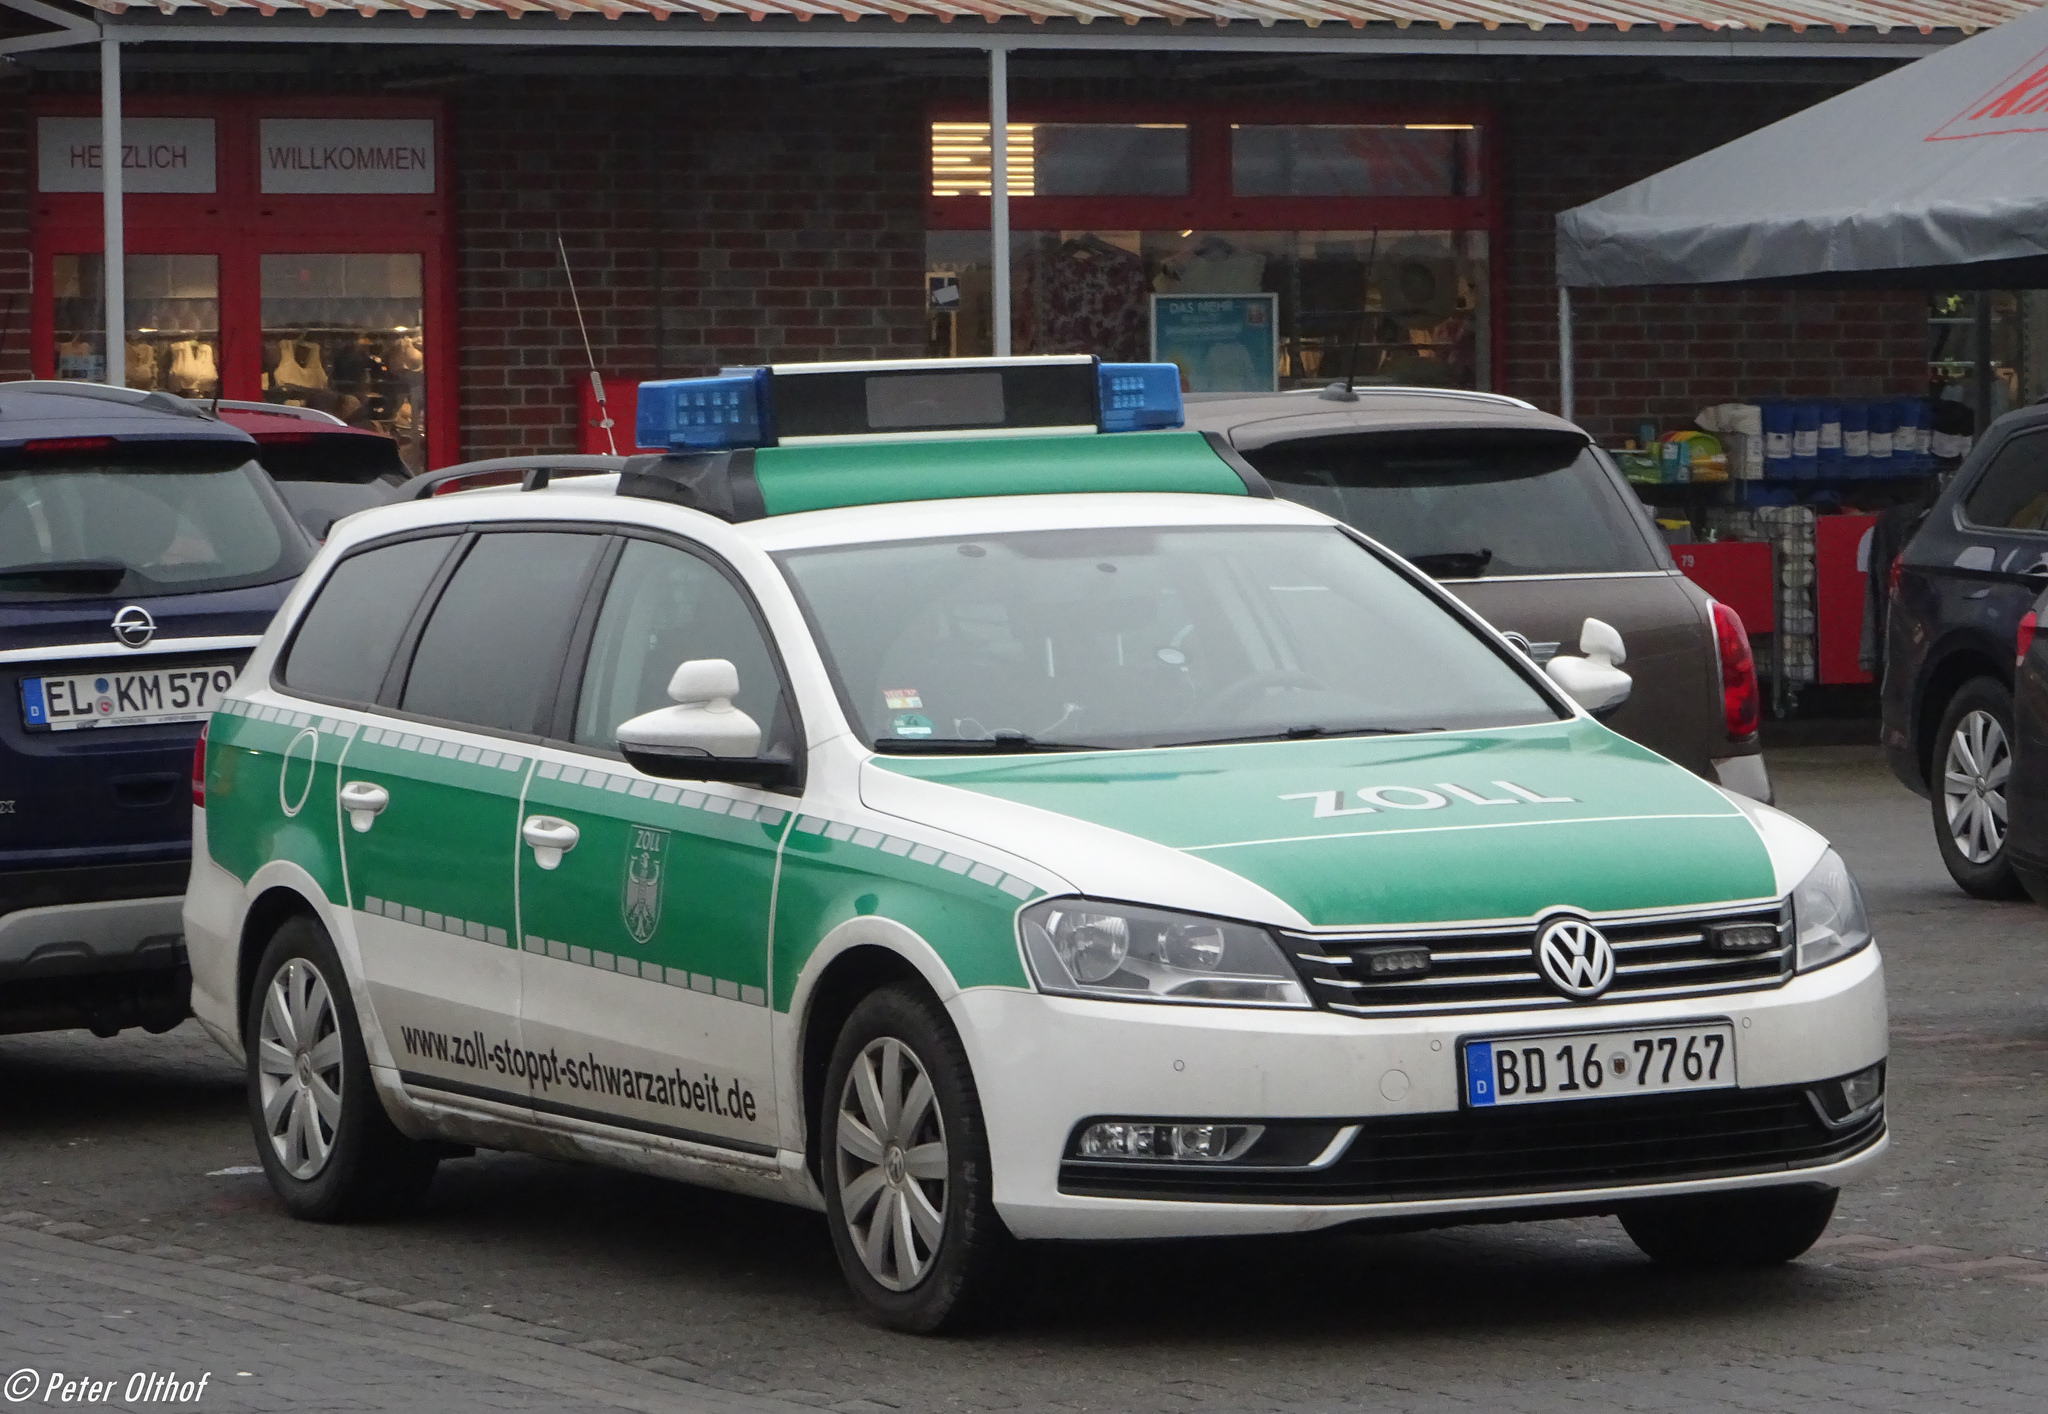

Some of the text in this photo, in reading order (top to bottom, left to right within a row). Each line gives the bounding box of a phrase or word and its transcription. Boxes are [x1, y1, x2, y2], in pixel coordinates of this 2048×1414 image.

[70, 144, 187, 168] HEZLICH
[267, 147, 426, 169] WILLKOMMEN
[1680, 554, 1695, 568] 79
[45, 680, 93, 717] EL
[115, 675, 163, 712] KM
[1277, 780, 1582, 818] ZOLL
[635, 830, 660, 852] ZOLL
[400, 1025, 757, 1122] www.zoll-stoppt-schwarzarbeit.de
[1476, 1034, 1725, 1096] D BD 16 7767
